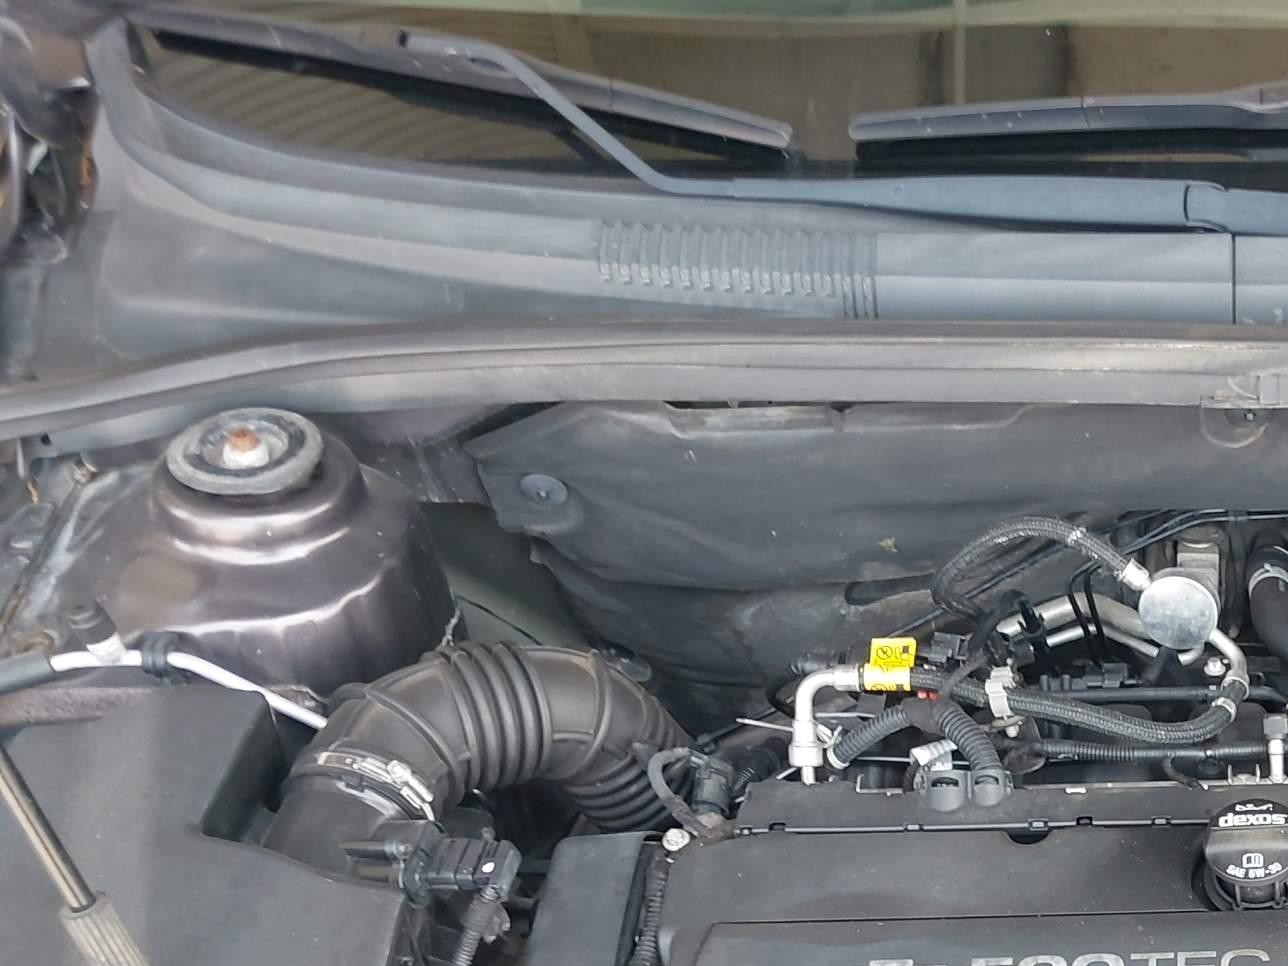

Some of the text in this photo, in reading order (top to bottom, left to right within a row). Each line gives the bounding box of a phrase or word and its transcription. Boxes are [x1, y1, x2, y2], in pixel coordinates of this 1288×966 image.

[1218, 812, 1288, 827] dexos
[1226, 862, 1282, 878] SAE 5W-30
